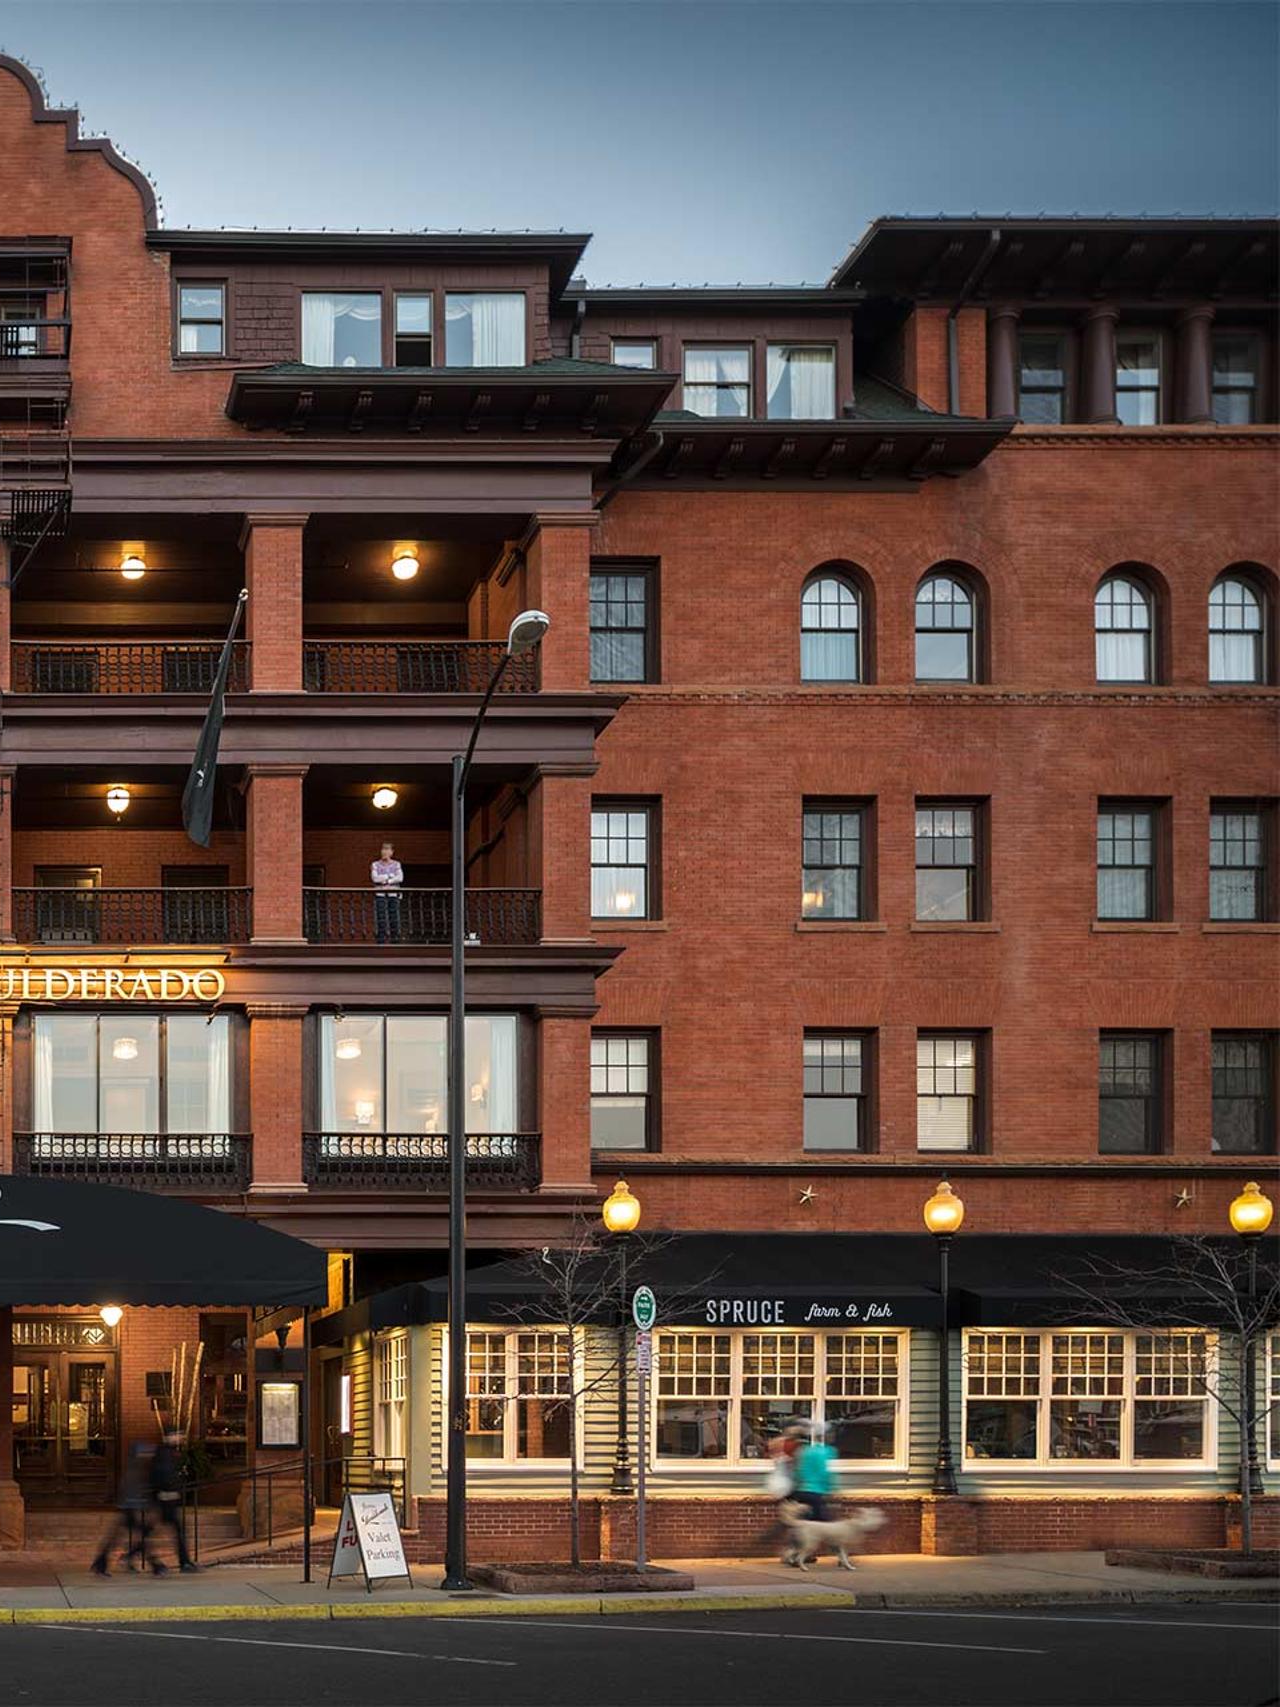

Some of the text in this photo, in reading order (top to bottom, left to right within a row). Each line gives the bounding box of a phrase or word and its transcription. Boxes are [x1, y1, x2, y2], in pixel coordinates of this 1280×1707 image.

[705, 1300, 893, 1324] SPRUCE farm & fish
[367, 1532, 392, 1543] Valet
[366, 1549, 401, 1562] Parking
